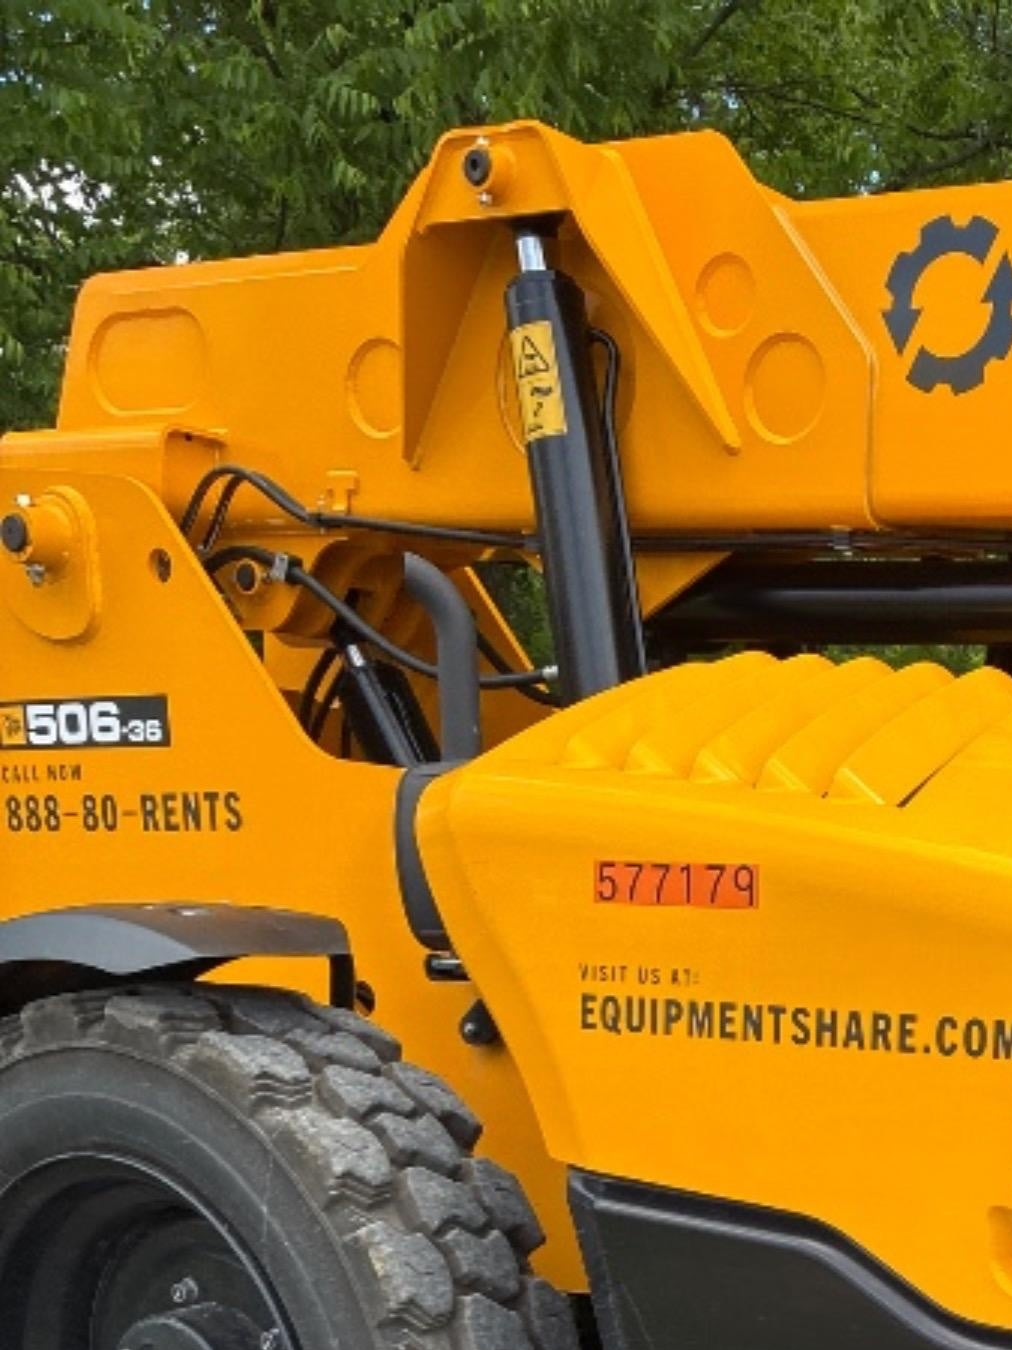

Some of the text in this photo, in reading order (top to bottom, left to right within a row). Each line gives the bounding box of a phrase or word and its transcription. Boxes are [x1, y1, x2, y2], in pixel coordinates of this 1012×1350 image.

[1, 763, 82, 783] CALL NOW
[5, 792, 243, 832] 888-80-RENTS
[597, 861, 756, 906] 577179
[578, 962, 629, 982] VISIT
[637, 965, 662, 985] US
